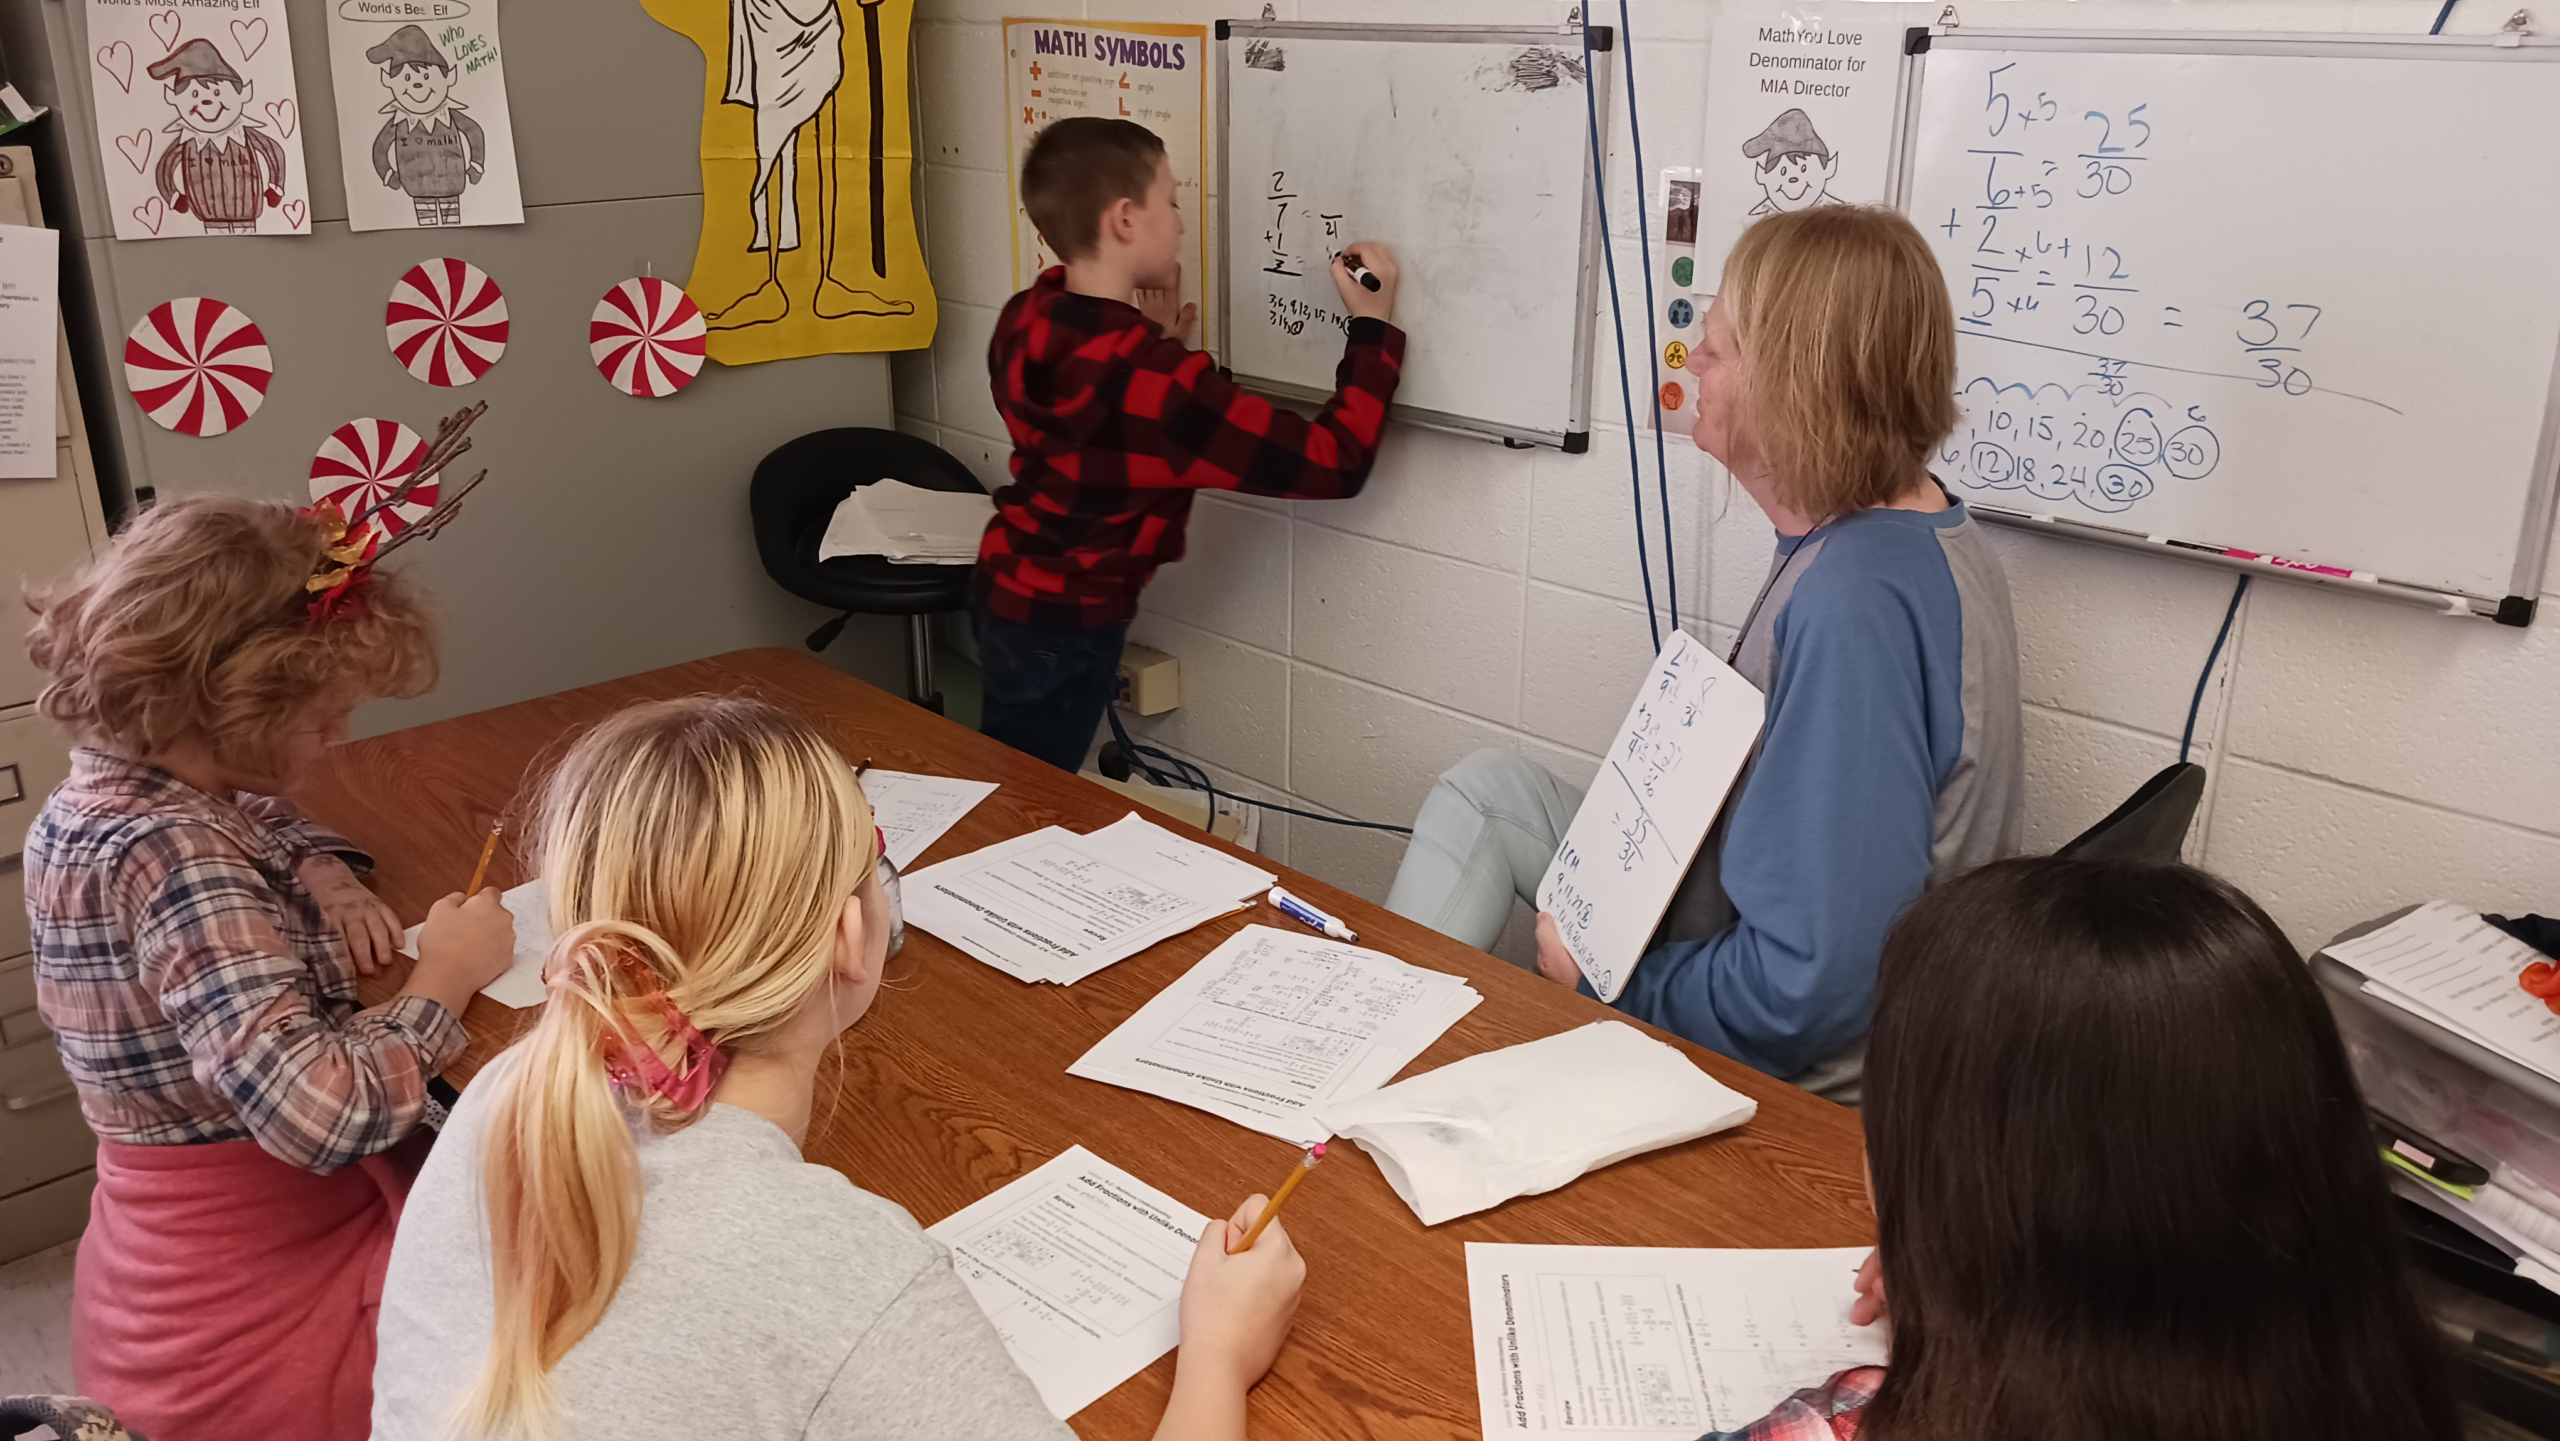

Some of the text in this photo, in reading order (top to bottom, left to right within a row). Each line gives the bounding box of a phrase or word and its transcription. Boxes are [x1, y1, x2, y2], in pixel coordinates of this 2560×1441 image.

[358, 2, 401, 14] World's
[434, 5, 449, 16] Elf
[454, 34, 487, 61] LOVES
[1034, 30, 1185, 70] MATH SYMBOLS
[1828, 30, 1863, 46] Love
[1749, 52, 1866, 72] Denominator for
[1760, 79, 1850, 97] MIA Director
[1986, 62, 2016, 137] 5
[2084, 103, 2151, 154] 25
[1272, 171, 1284, 192] 2
[2077, 161, 2132, 198] 30
[1977, 215, 2005, 254] 2
[2086, 245, 2130, 279] 12
[1972, 277, 2000, 318] 5
[2073, 295, 2124, 335] 30
[2237, 300, 2321, 346] 37
[2256, 358, 2312, 396] 30
[934, 885, 1078, 956] Add Fractions with Unlike Denominators
[1135, 1058, 1195, 1077] Denominators
[1196, 1075, 1222, 1084] Unlike
[1242, 1087, 1285, 1102] Fractions
[1054, 1195, 1075, 1209] Review
[1078, 1176, 1097, 1186] Add
[1095, 1182, 1131, 1207] Fractions
[1133, 1206, 1149, 1216] with
[1149, 1214, 1174, 1230] Unlike
[1502, 1274, 1527, 1428] Add Fractions with Unlike Denominators
[1565, 1400, 1573, 1425] Review
